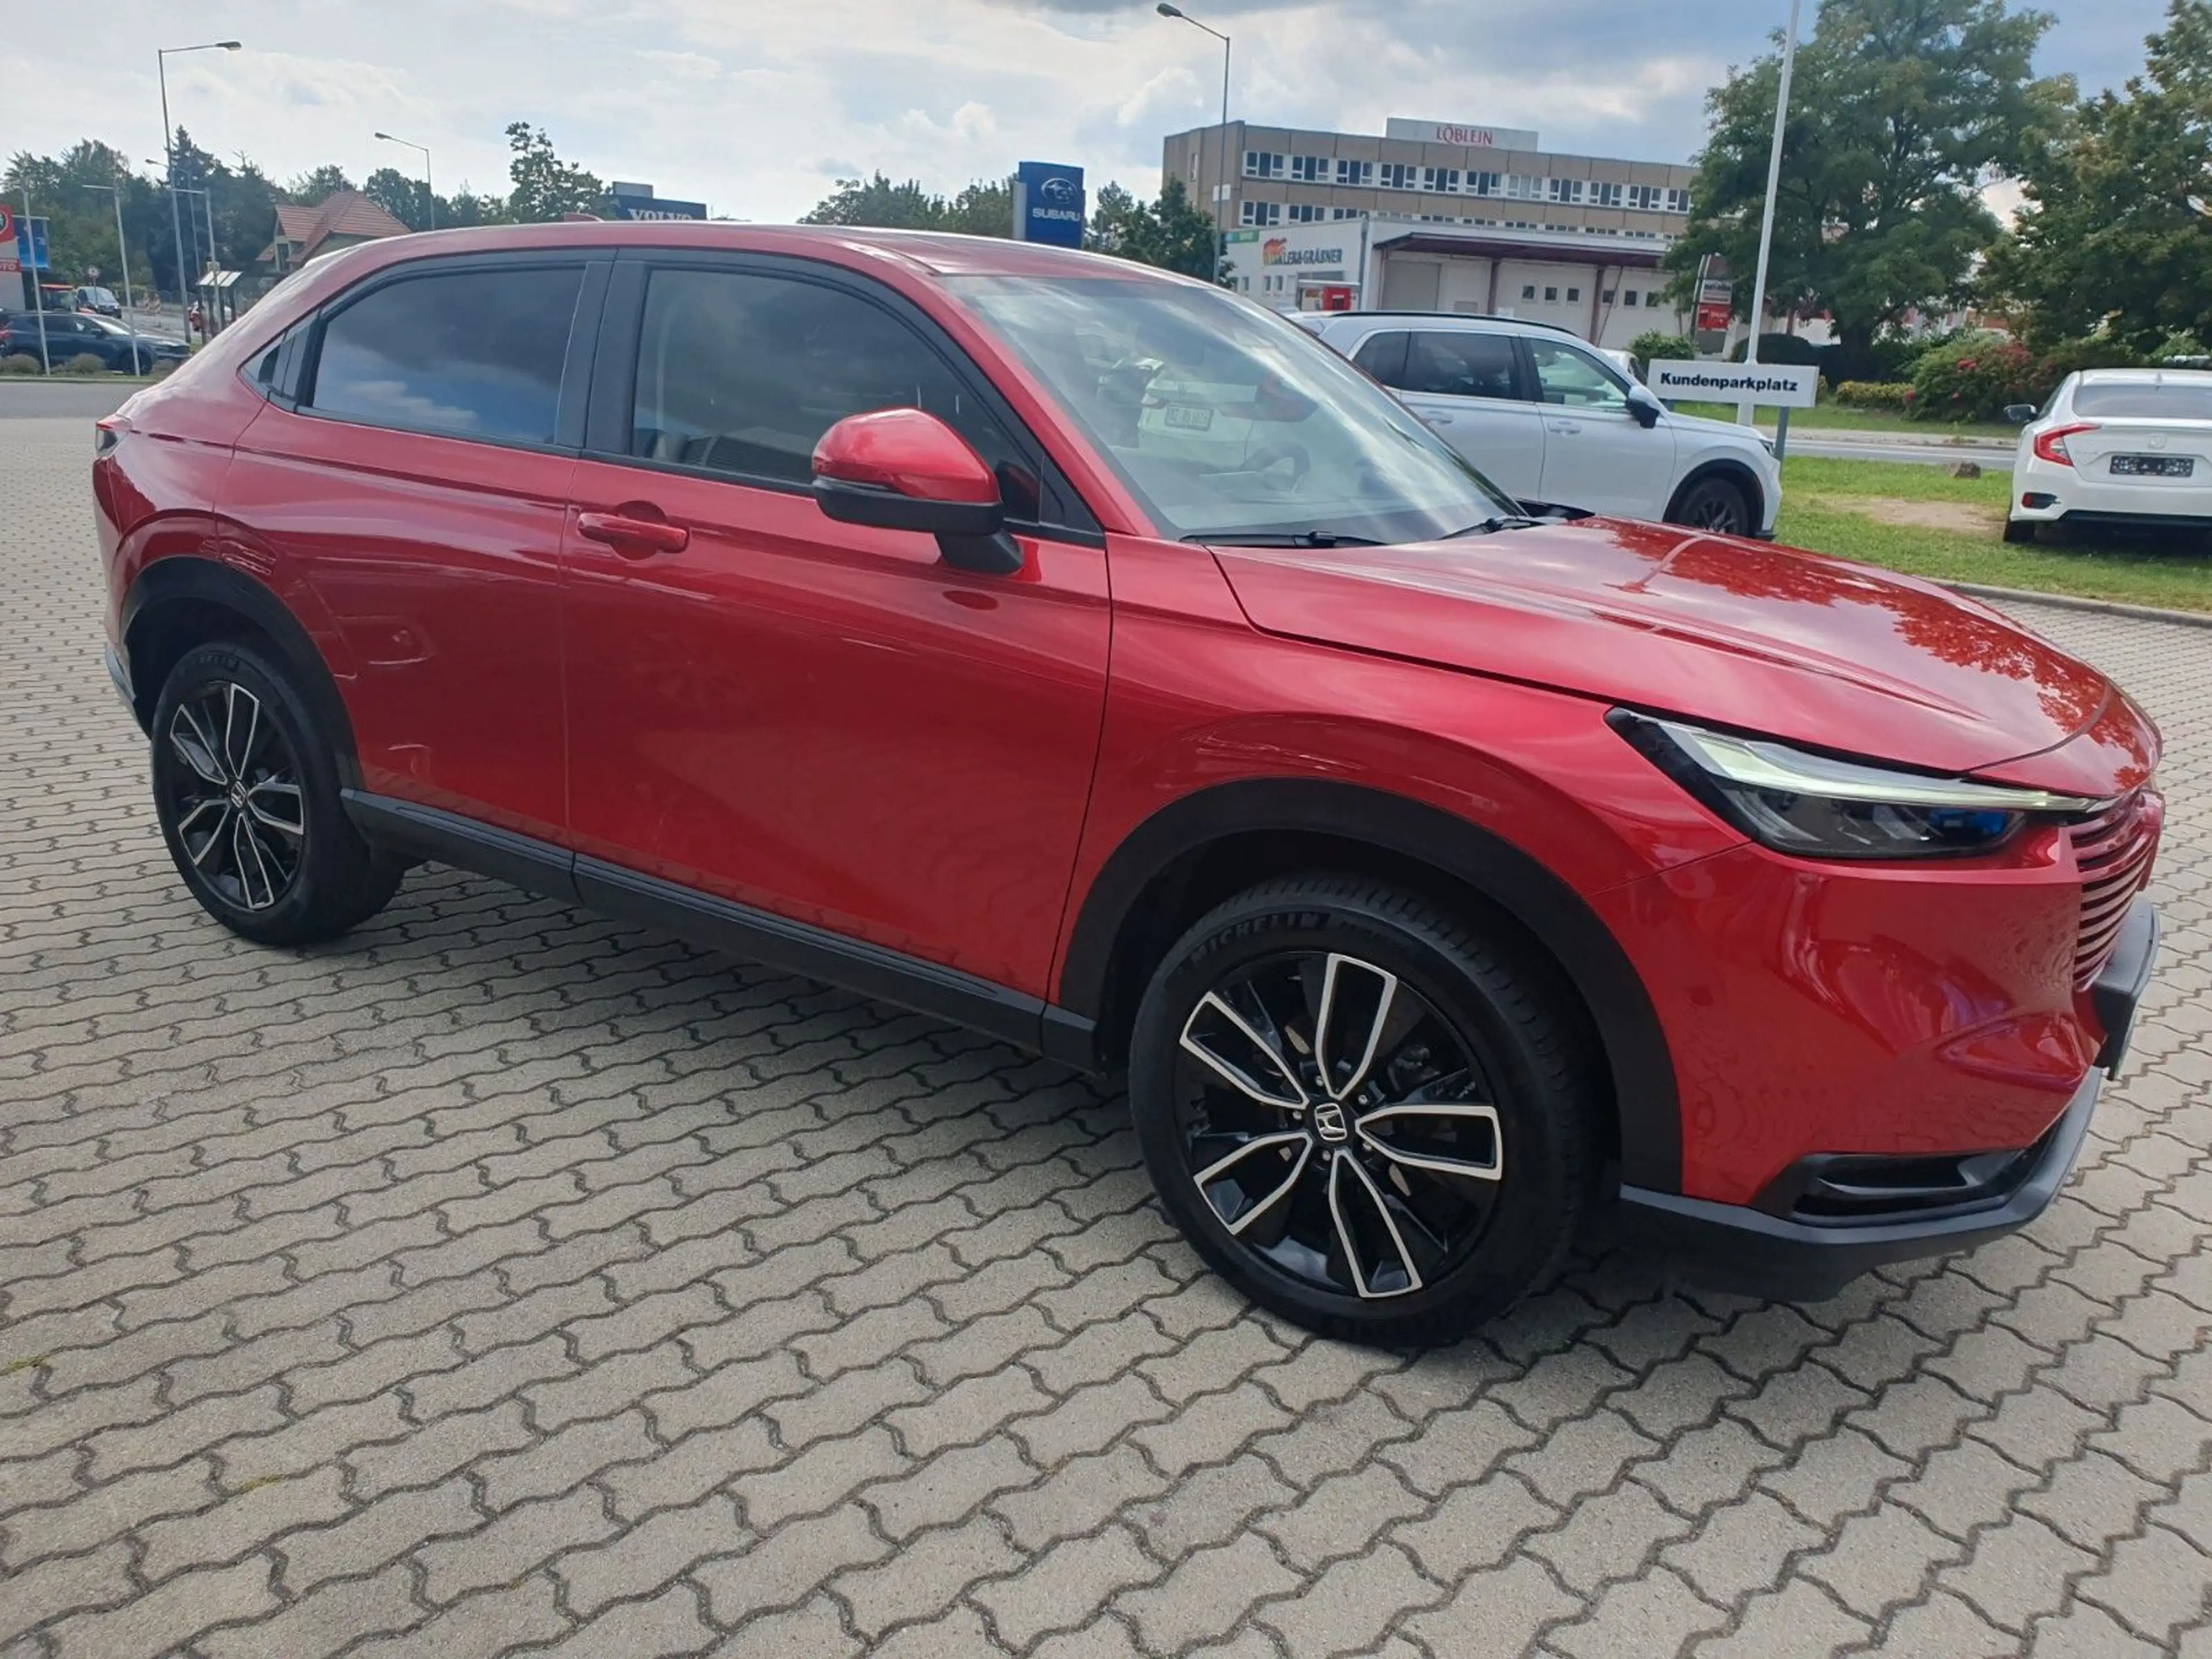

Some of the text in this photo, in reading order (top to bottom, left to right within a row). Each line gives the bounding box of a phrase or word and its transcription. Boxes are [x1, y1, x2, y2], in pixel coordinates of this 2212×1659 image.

[1032, 208, 1081, 222] SUBARU
[1660, 372, 1798, 392] Kundenparkplatz
[1188, 911, 1319, 963] MICHELIN
